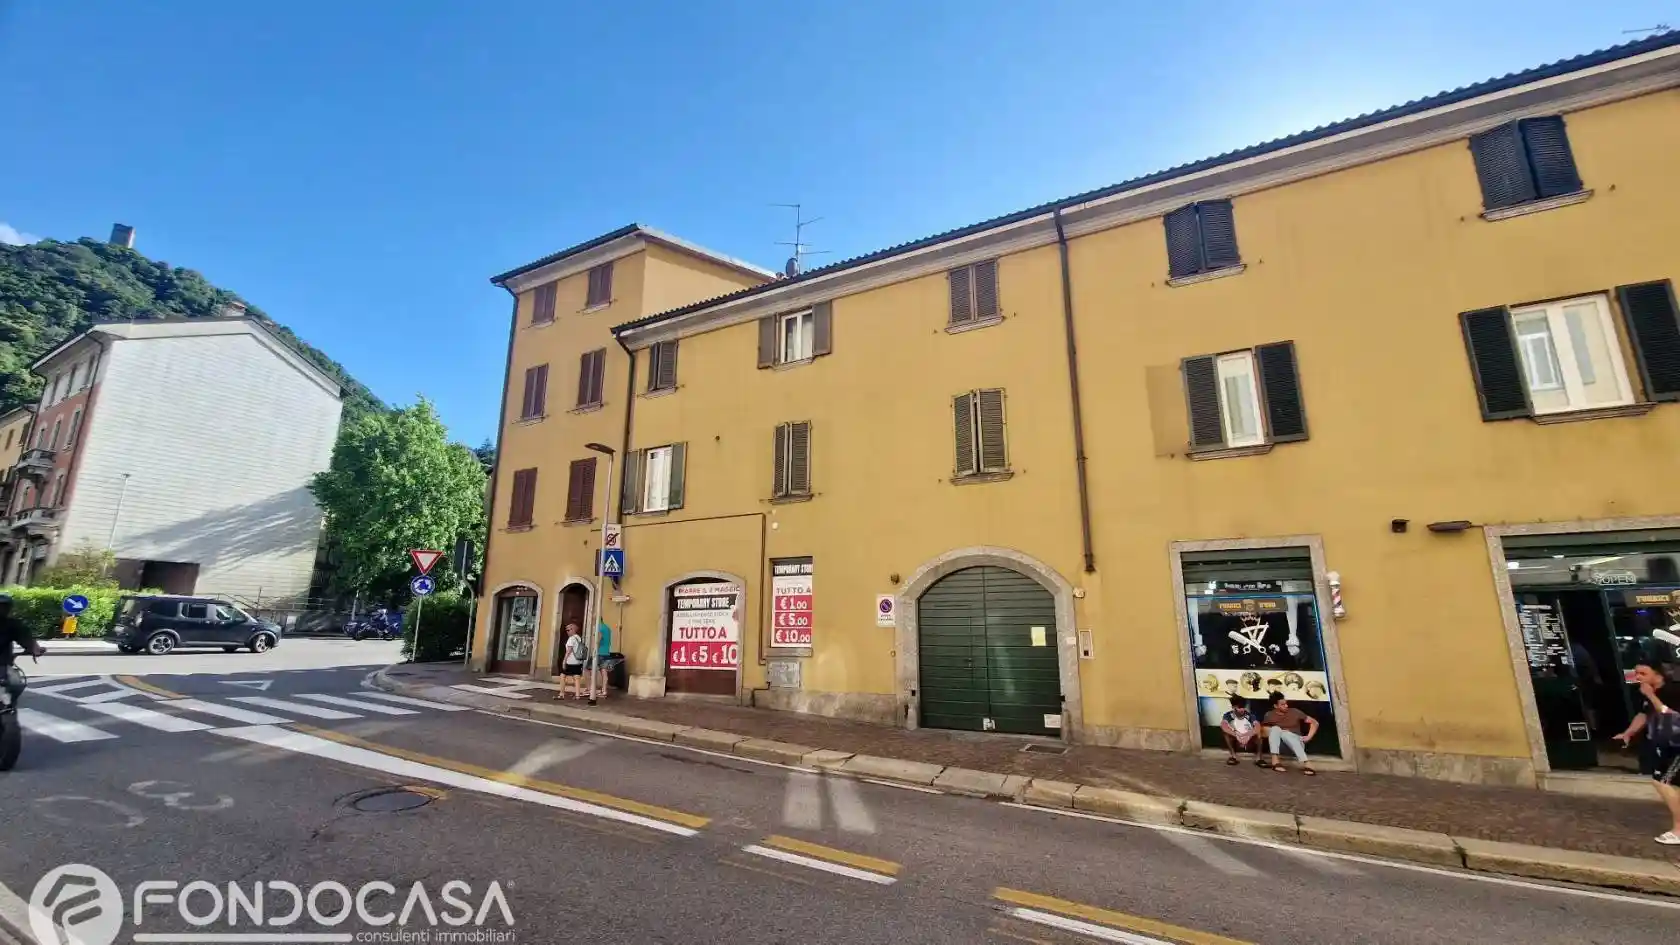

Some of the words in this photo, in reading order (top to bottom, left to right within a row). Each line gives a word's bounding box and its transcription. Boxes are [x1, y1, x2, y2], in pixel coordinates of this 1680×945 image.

[1603, 575, 1635, 584] OPEN
[777, 587, 803, 595] TUTTO
[677, 597, 711, 609] TEMPORARY
[712, 597, 730, 608] STORE
[679, 627, 716, 639] TUTTO
[718, 627, 727, 639] A
